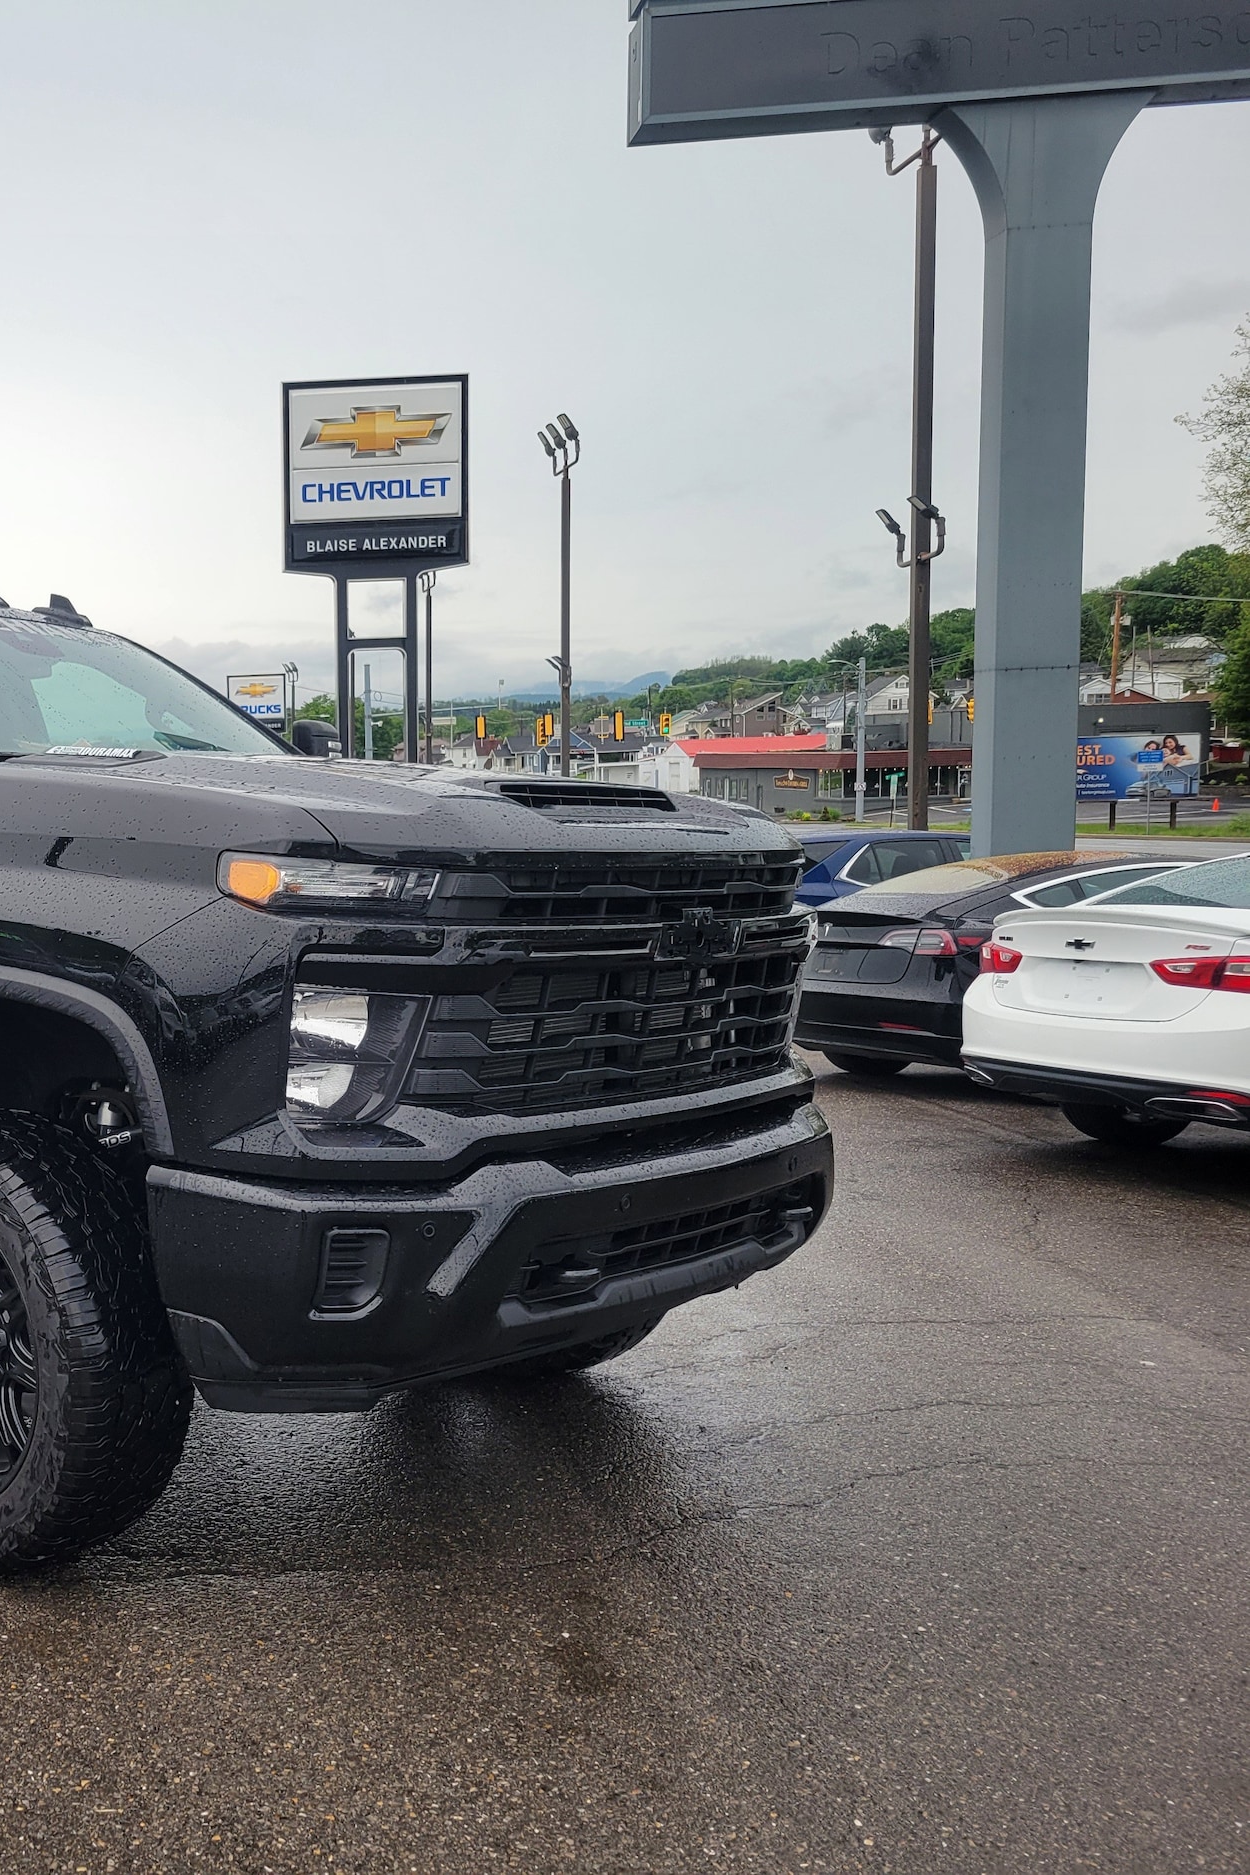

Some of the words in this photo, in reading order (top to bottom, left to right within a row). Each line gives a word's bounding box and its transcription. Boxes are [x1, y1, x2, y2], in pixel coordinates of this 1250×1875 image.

[820, 31, 974, 75] Dean
[999, 12, 1250, 66] Patterso
[301, 477, 451, 503] CHEVROLET
[306, 539, 357, 553] BLAISE
[363, 535, 447, 551] ALEXANDER
[240, 704, 281, 714] RUCKS
[80, 747, 138, 759] DURAMAX
[1077, 745, 1101, 756] EST
[1077, 755, 1116, 766] URED
